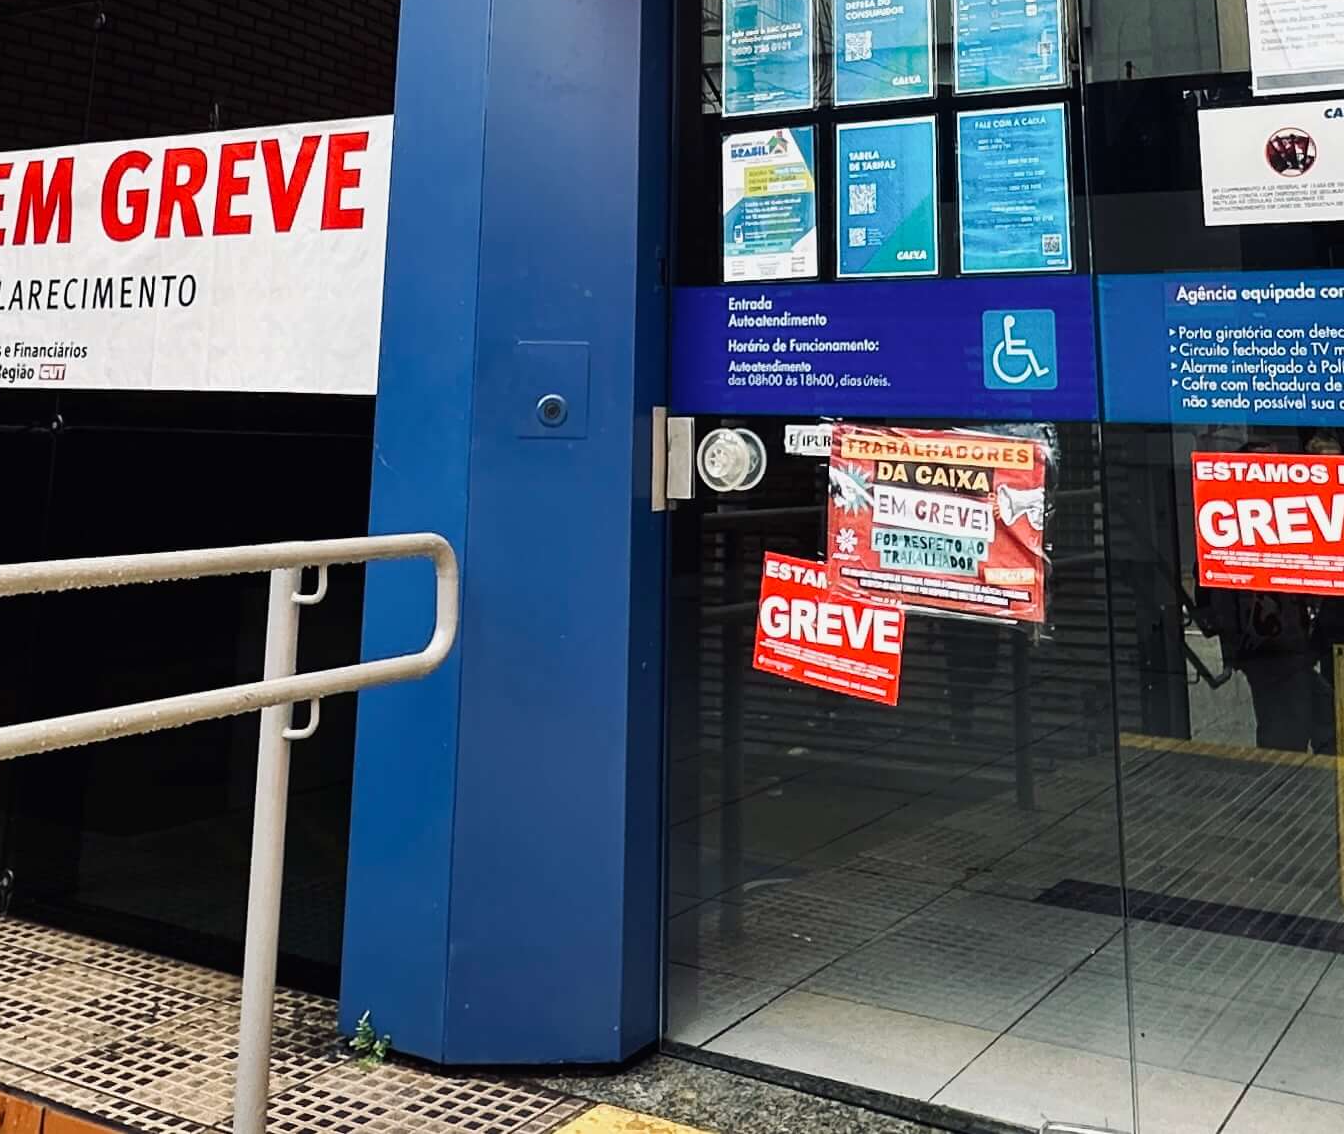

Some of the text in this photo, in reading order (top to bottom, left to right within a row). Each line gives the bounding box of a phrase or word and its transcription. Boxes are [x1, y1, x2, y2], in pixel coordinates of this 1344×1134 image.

[845, 6, 904, 21] CONSUMIDOR
[101, 131, 369, 242] GREVE
[897, 250, 927, 261] CAIXA
[728, 295, 773, 311] Entrada
[1176, 285, 1237, 305] Agência
[1241, 282, 1315, 304] equipada
[728, 311, 827, 327] Autoatendimento
[1178, 326, 1212, 339] Porta
[1216, 325, 1272, 342] giratória
[1276, 329, 1304, 339] com
[4, 345, 10, 357] e
[13, 342, 87, 359] Financiários
[728, 338, 880, 353] Horário de Funcionamento:
[1179, 342, 1229, 357] Circuito
[1233, 341, 1286, 356] fechado
[1290, 341, 1307, 356] de
[1310, 342, 1329, 356] TV
[728, 359, 811, 372] Autoatendimento
[1180, 358, 1228, 373] Alarme
[1232, 358, 1304, 378] interligado
[1307, 359, 1317, 373] à
[728, 374, 891, 388] das 08h00 às 18h00, dias úteis.
[1181, 376, 1217, 391] Cofre
[1221, 380, 1248, 391] com
[1253, 375, 1320, 391] fechadura
[1324, 376, 1342, 391] de
[1183, 396, 1207, 408] não
[1212, 393, 1250, 409] sendo
[1254, 394, 1306, 412] possível
[1311, 399, 1335, 409] sua
[789, 433, 831, 452] EPUR
[847, 438, 1030, 464] TRABALHADORES
[877, 462, 990, 492] DA CAIXA
[1196, 461, 1329, 484] ESTAMOS
[879, 494, 989, 532] EM GREVE!
[904, 534, 962, 553] RESPEITO
[766, 560, 829, 589] ESTAM
[760, 596, 901, 654] GREVE
